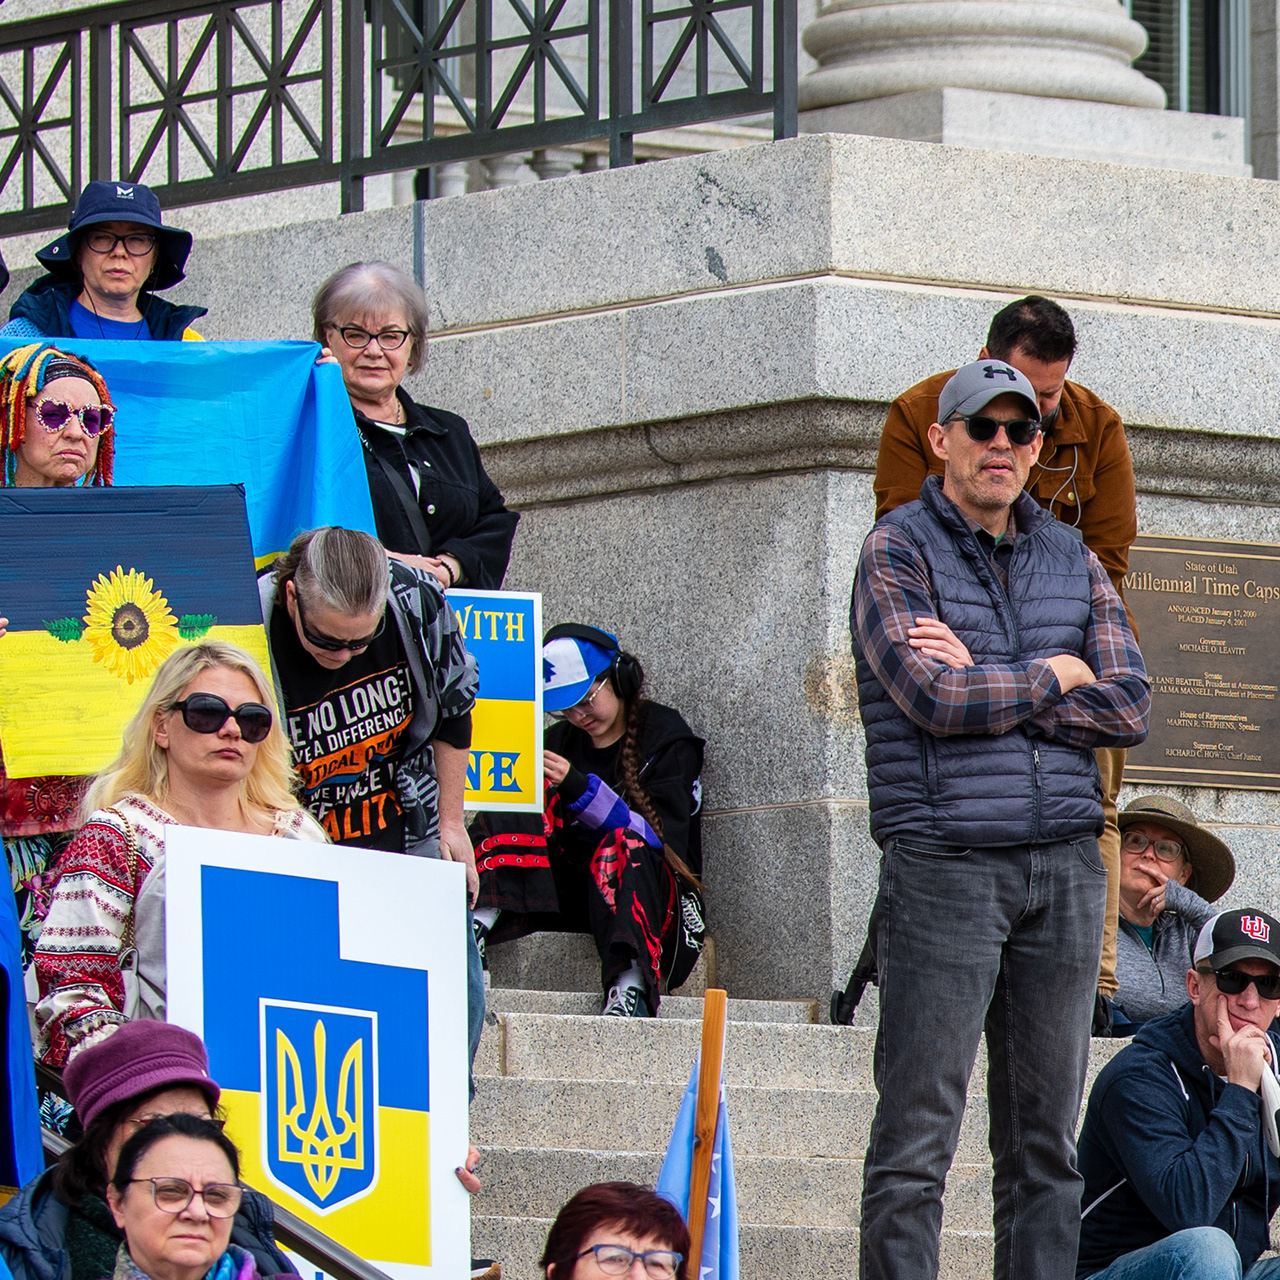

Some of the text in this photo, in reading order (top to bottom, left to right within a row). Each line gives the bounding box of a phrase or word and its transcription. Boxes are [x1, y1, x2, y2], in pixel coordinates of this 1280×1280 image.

[1185, 560, 1238, 575] State of Utah
[1122, 571, 1197, 594] Millennial
[1202, 576, 1240, 597] Time
[1168, 604, 1211, 615] ANNOUNCED
[1178, 614, 1204, 624] PLACED
[1179, 644, 1210, 653] MICHAEL
[1218, 647, 1246, 655] LEAVITT
[1159, 685, 1179, 693] ALMA
[308, 701, 338, 740] NO
[1166, 719, 1193, 727] MARTIN
[1201, 720, 1236, 731] STEPHENS,
[314, 740, 325, 757] A
[1165, 748, 1196, 758] RICHARD
